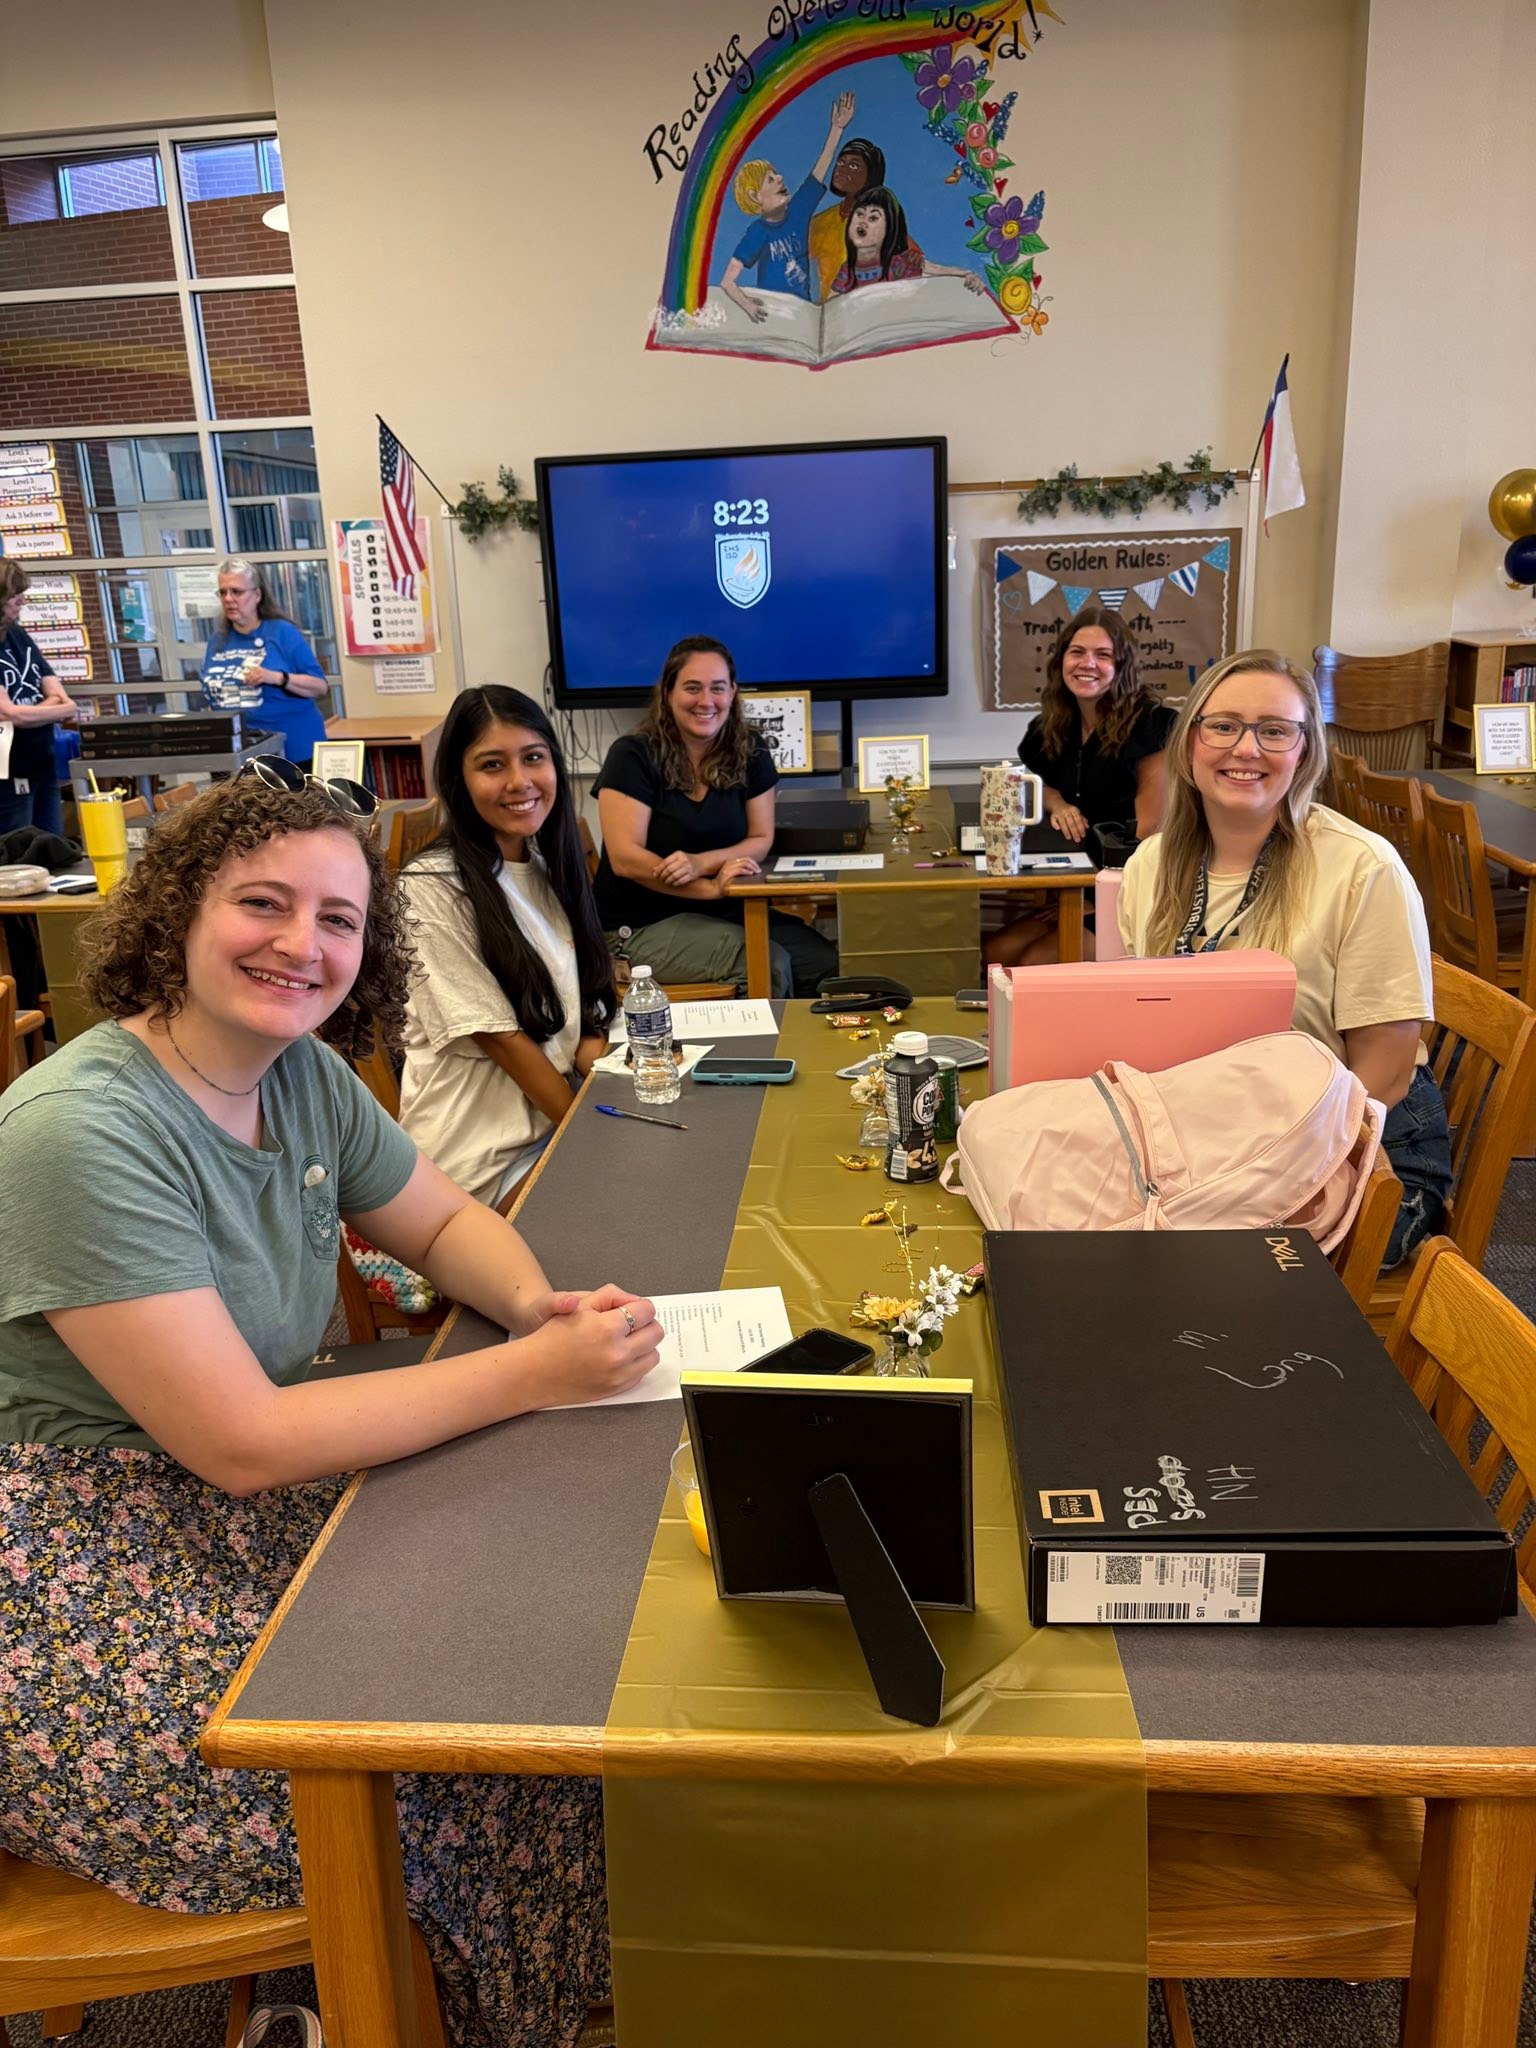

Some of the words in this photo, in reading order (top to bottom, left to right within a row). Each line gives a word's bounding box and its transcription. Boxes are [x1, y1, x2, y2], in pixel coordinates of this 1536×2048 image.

[643, 34, 754, 184] Reading
[8, 448, 24, 457] Level
[12, 478, 29, 486] Level
[713, 498, 770, 527] 8:23
[351, 539, 366, 600] SPECIALS
[1046, 549, 1108, 572] Golden
[1116, 548, 1171, 569] Rules:
[1023, 617, 1065, 635] Treat
[1140, 660, 1184, 670] indness
[1264, 1236, 1304, 1272] DELL
[1067, 1496, 1085, 1515] intel
[1196, 1606, 1206, 1618] US
